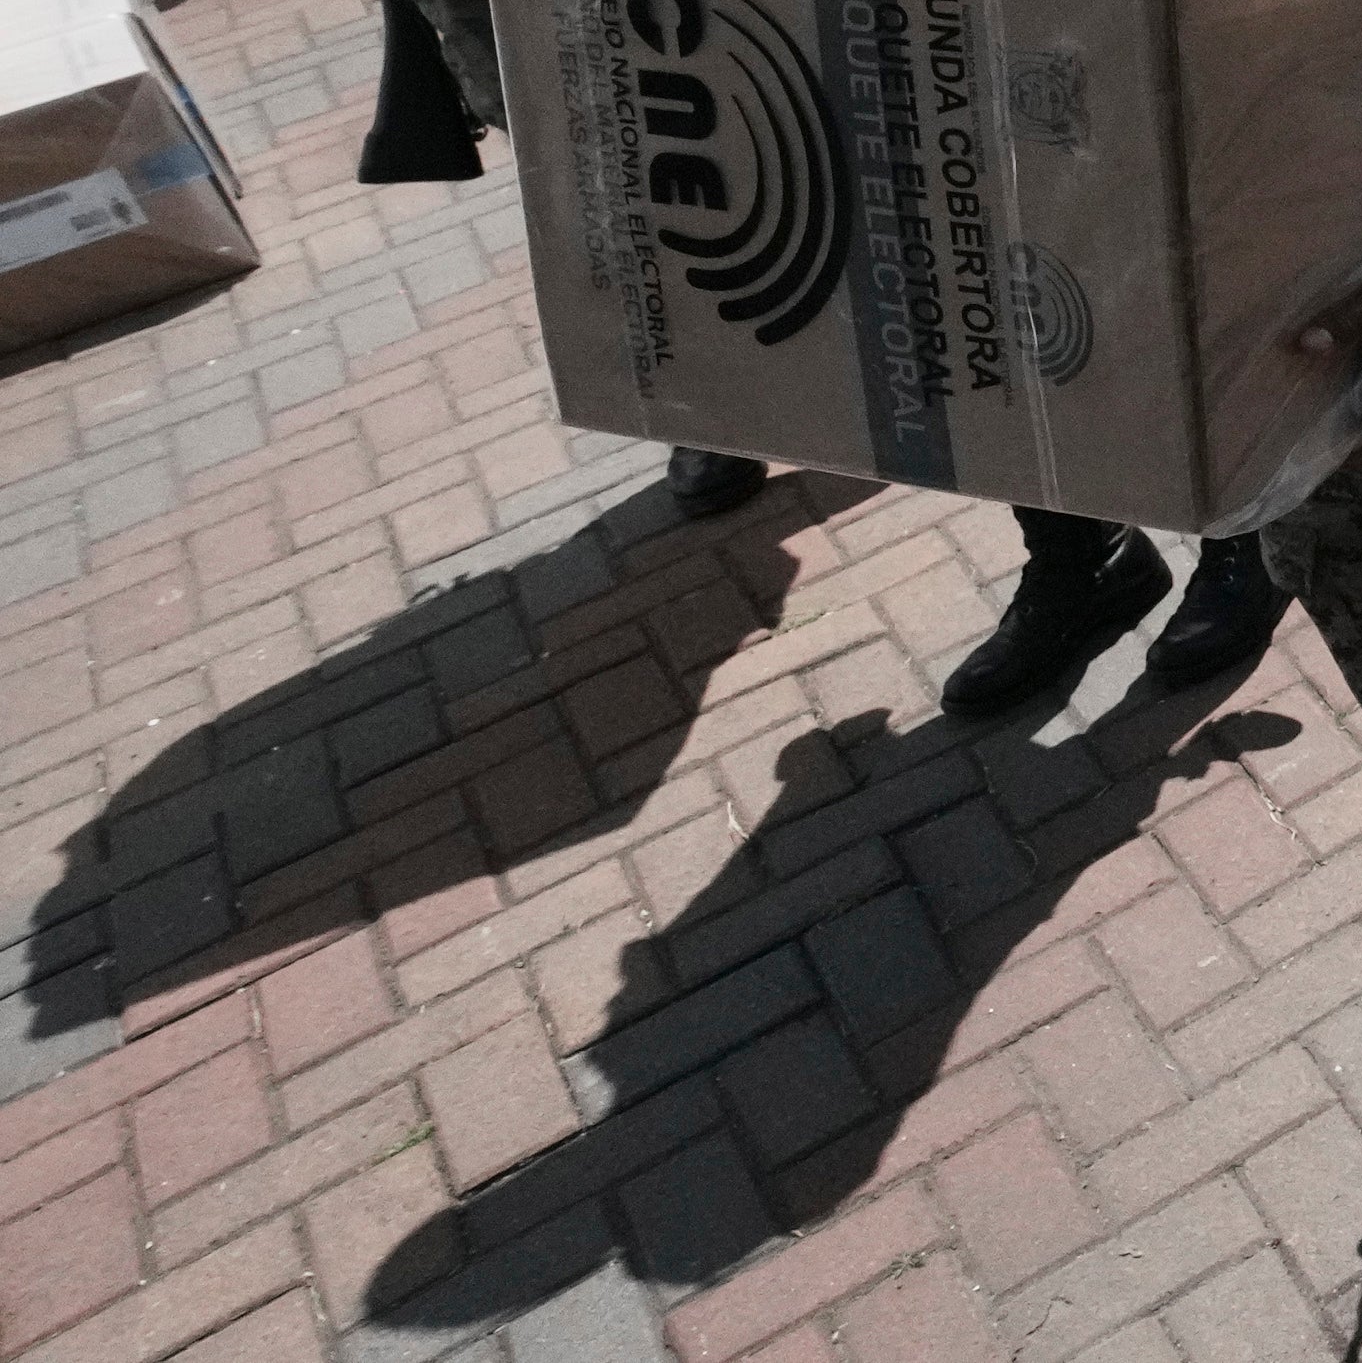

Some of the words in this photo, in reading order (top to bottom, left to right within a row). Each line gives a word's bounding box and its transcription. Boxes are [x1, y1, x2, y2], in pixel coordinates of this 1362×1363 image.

[610, 57, 643, 206] NACIONAL
[627, 214, 675, 366] ELECTORAL
[861, 175, 926, 444] ELECTORAL
[892, 163, 954, 407] ELECTORAL
[938, 128, 1002, 390] COBERTORA
